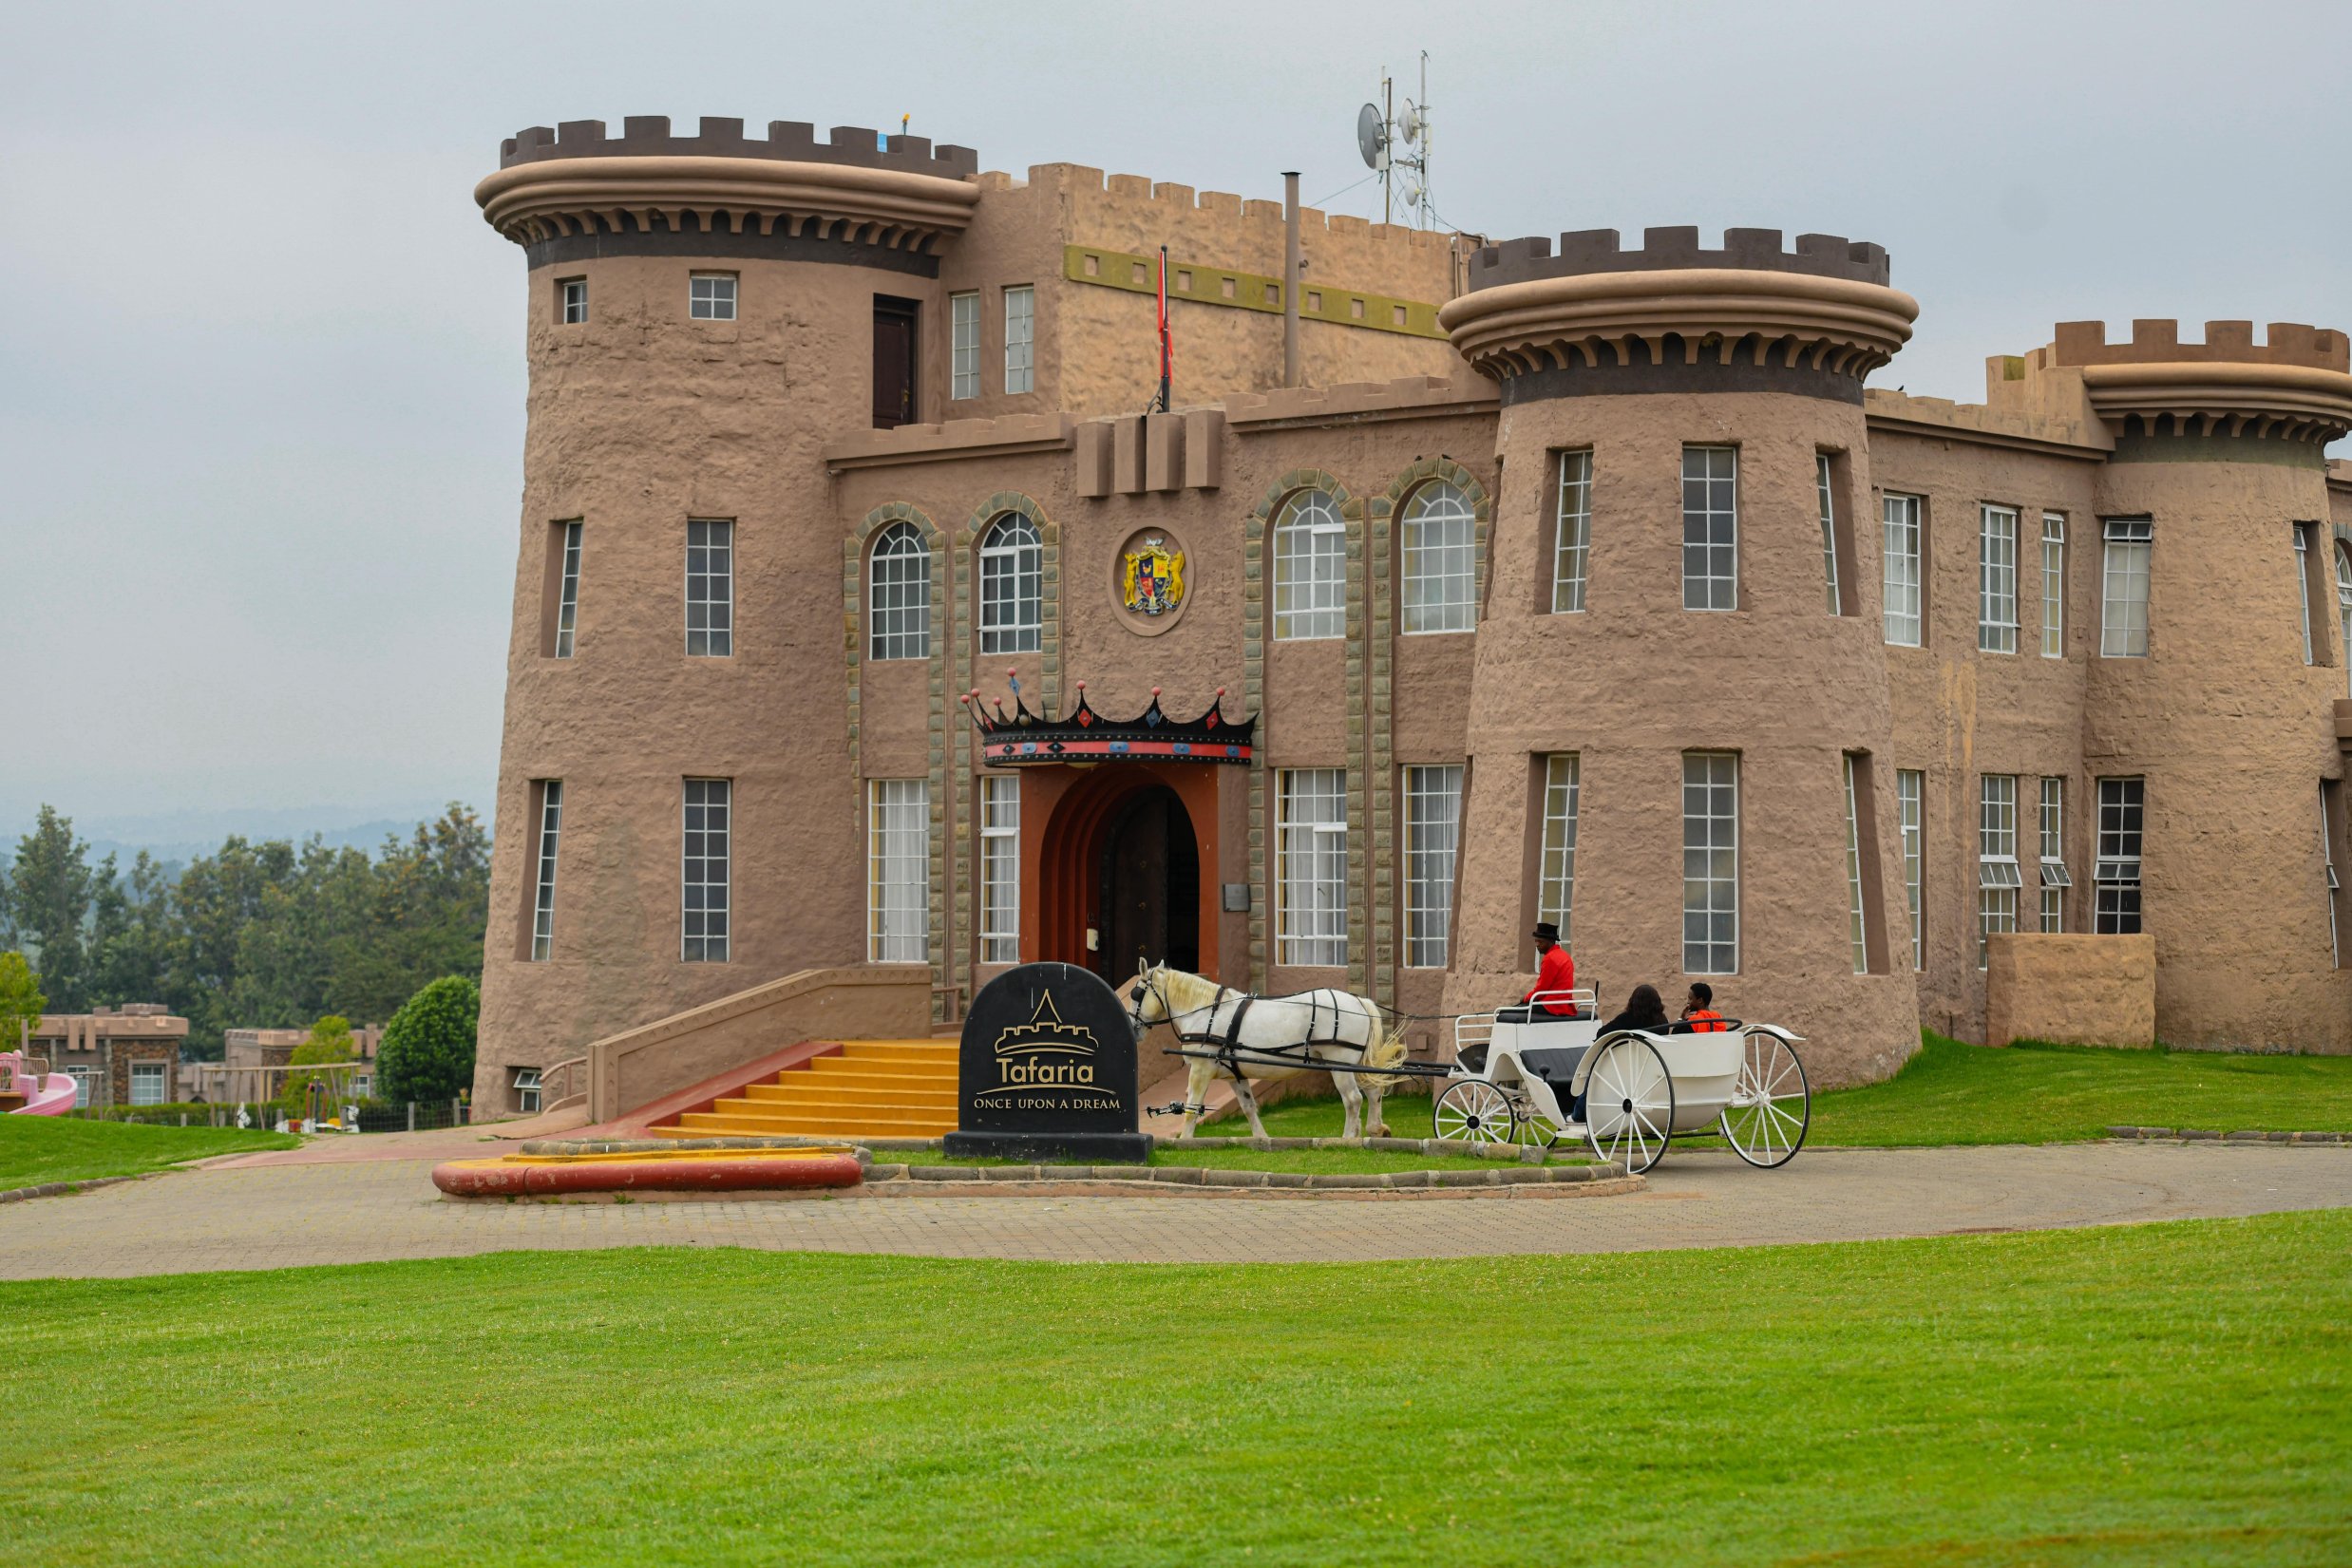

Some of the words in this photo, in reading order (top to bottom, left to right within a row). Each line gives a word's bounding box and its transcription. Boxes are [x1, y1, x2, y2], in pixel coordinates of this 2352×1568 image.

[996, 1056, 1093, 1083] Tafaria
[974, 1099, 1012, 1109] ONCE
[1017, 1099, 1055, 1109] UPON
[1059, 1099, 1069, 1109] A
[1073, 1099, 1120, 1109] DREAM
